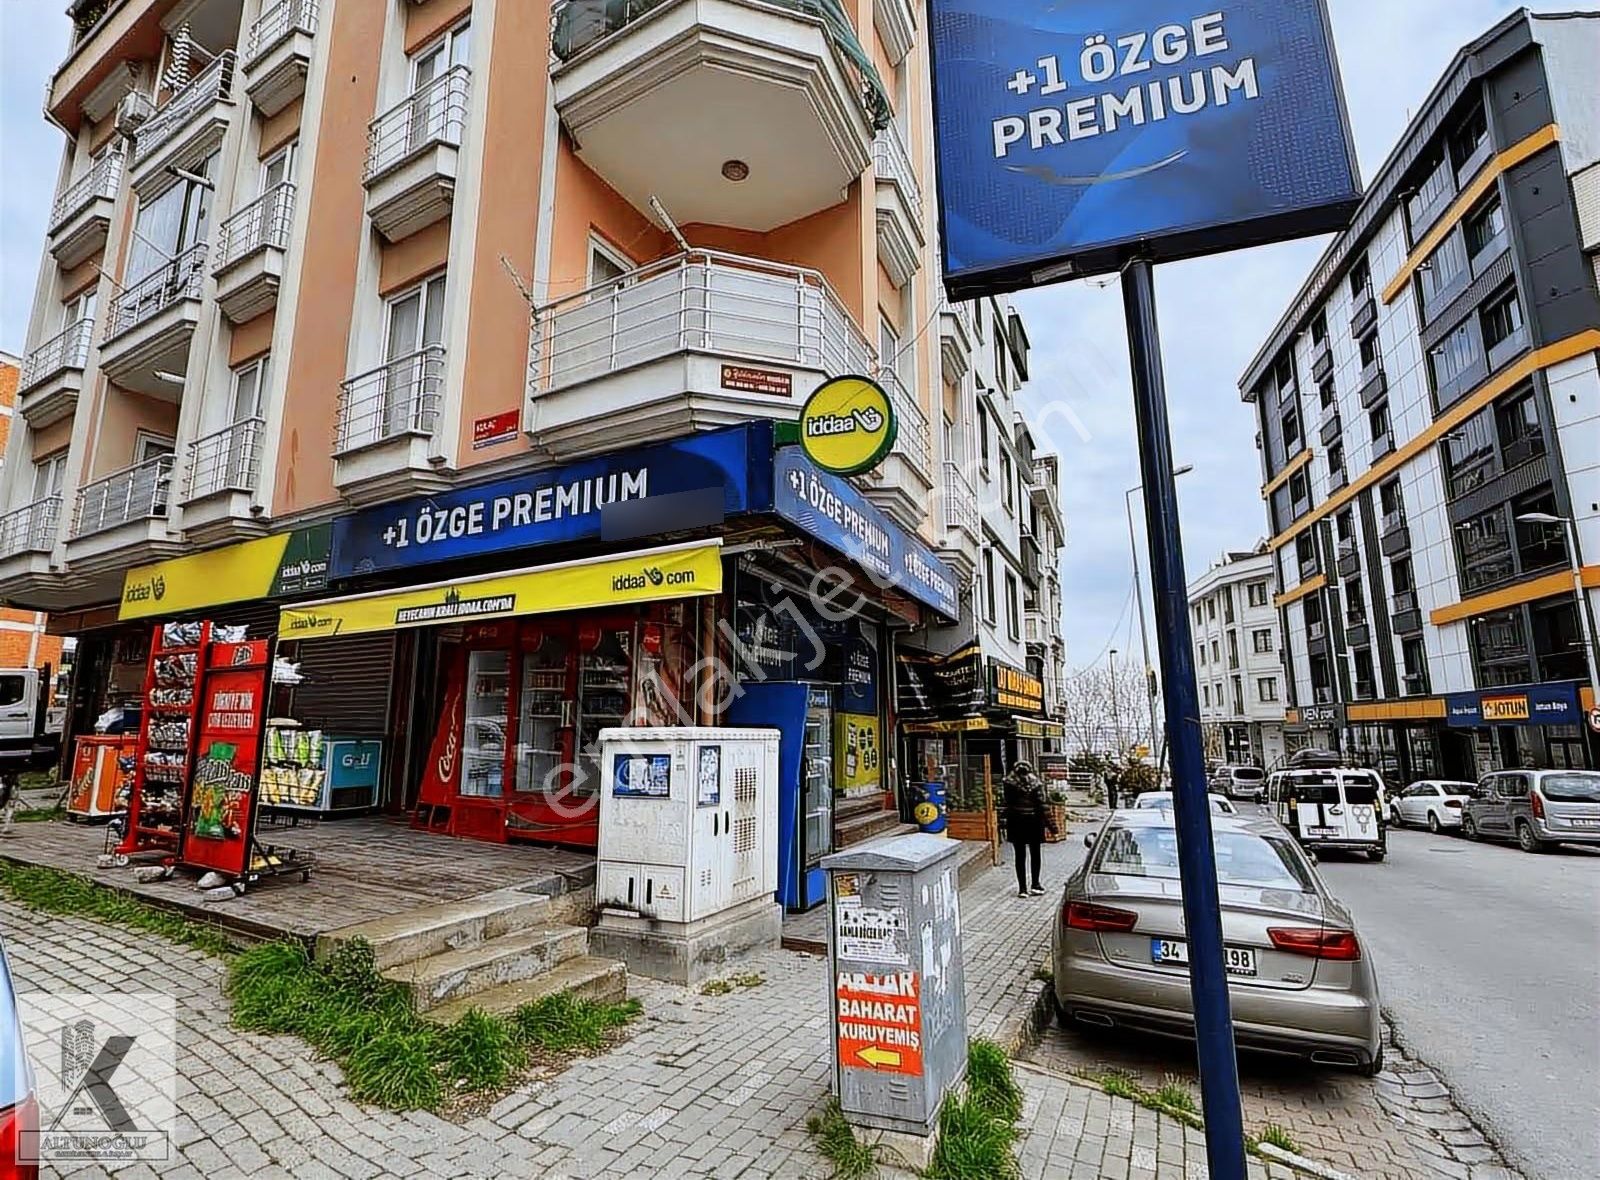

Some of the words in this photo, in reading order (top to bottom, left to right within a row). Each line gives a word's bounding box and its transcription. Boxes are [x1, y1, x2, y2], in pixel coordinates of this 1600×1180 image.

[1007, 56, 1066, 96] +1
[1080, 11, 1229, 82] ÖZGE
[993, 58, 1259, 158] PREMIUM
[808, 416, 854, 436] iddaa
[383, 519, 408, 548] +1
[415, 502, 484, 545] ÖZGE
[492, 467, 648, 531] PREMIUM
[789, 469, 807, 499] +1
[809, 474, 842, 523] ÖZGE
[844, 504, 890, 557] PREMIUM
[611, 575, 645, 591] iddaa
[666, 569, 695, 585] com
[1495, 701, 1526, 716] JOTUN
[1161, 941, 1180, 958] 34
[839, 998, 917, 1024] BAHARAT
[839, 1021, 920, 1052] KURUYEMİŞ
